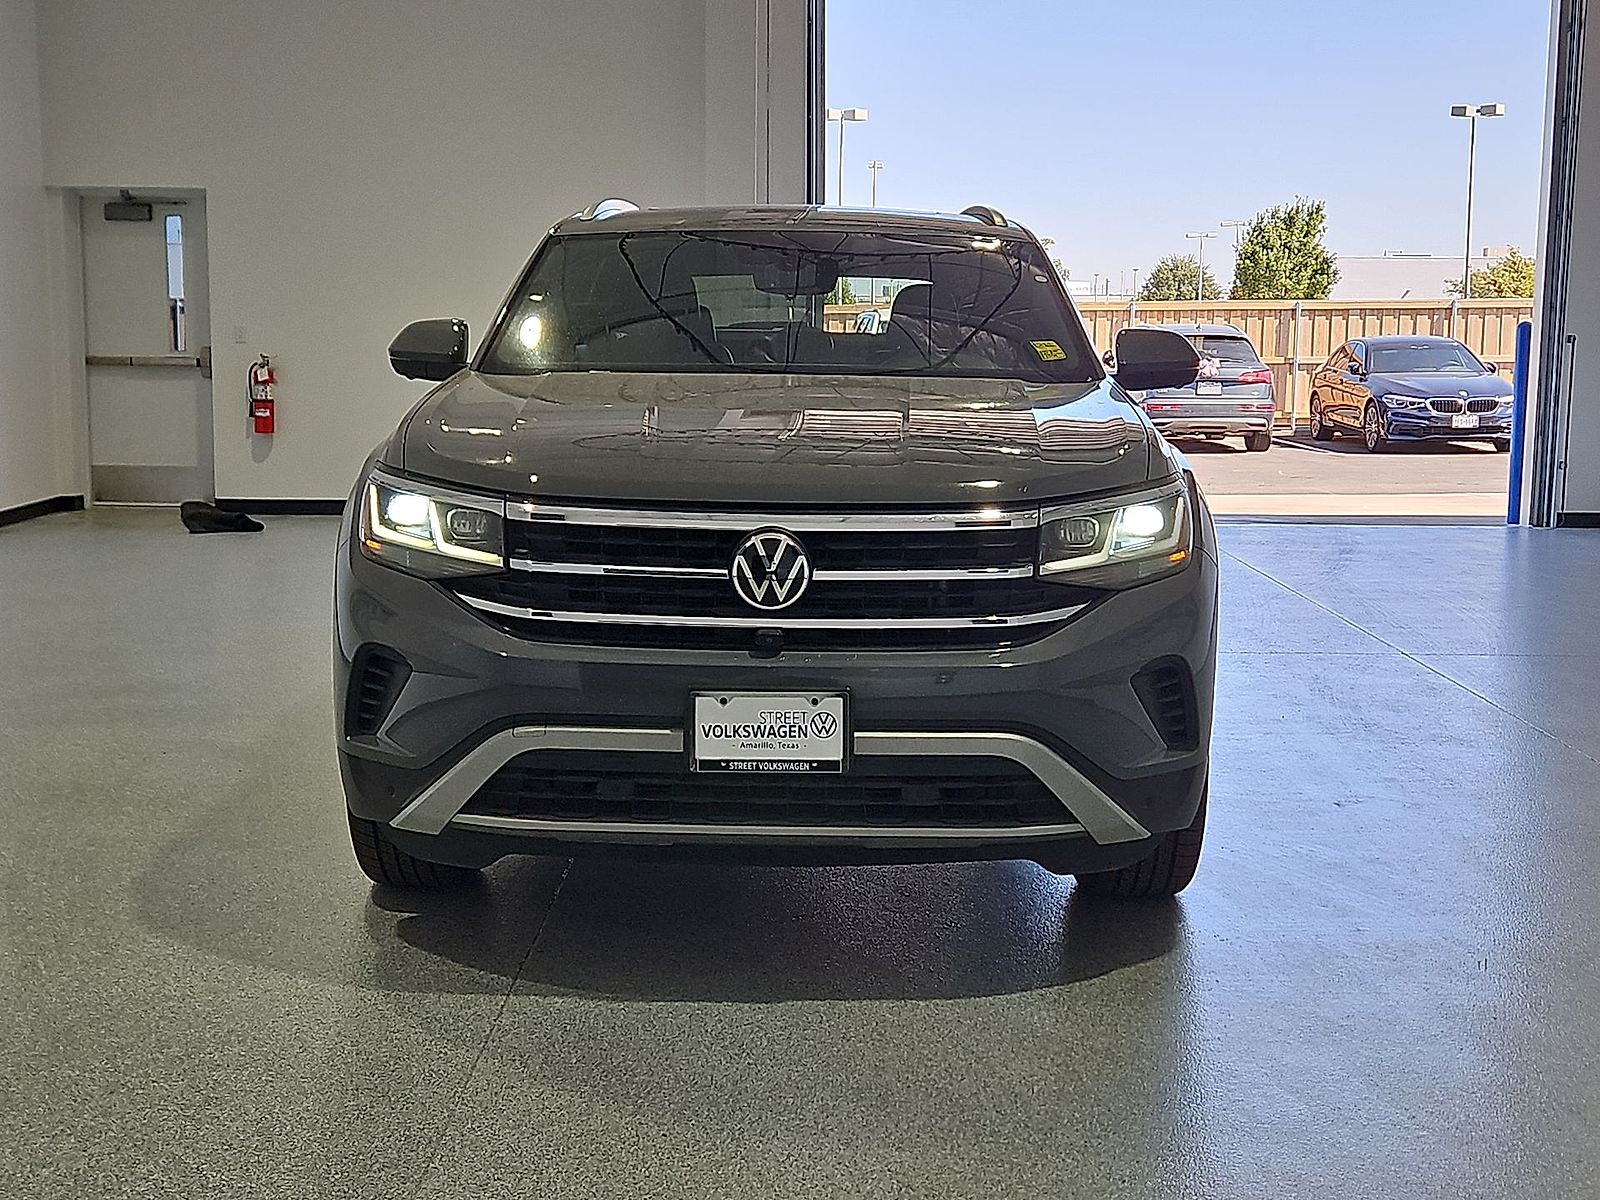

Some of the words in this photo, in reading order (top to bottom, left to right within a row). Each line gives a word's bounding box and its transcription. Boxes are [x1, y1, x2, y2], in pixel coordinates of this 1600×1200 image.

[733, 533, 809, 609] VW
[759, 711, 808, 724] STREET
[701, 724, 808, 738] VOLKSWAGEN
[810, 711, 837, 738] VW
[739, 741, 776, 750] Amarillo,
[777, 741, 799, 749] Texas
[729, 762, 757, 770] STREET
[758, 762, 809, 770] VOLKSWAGEN
